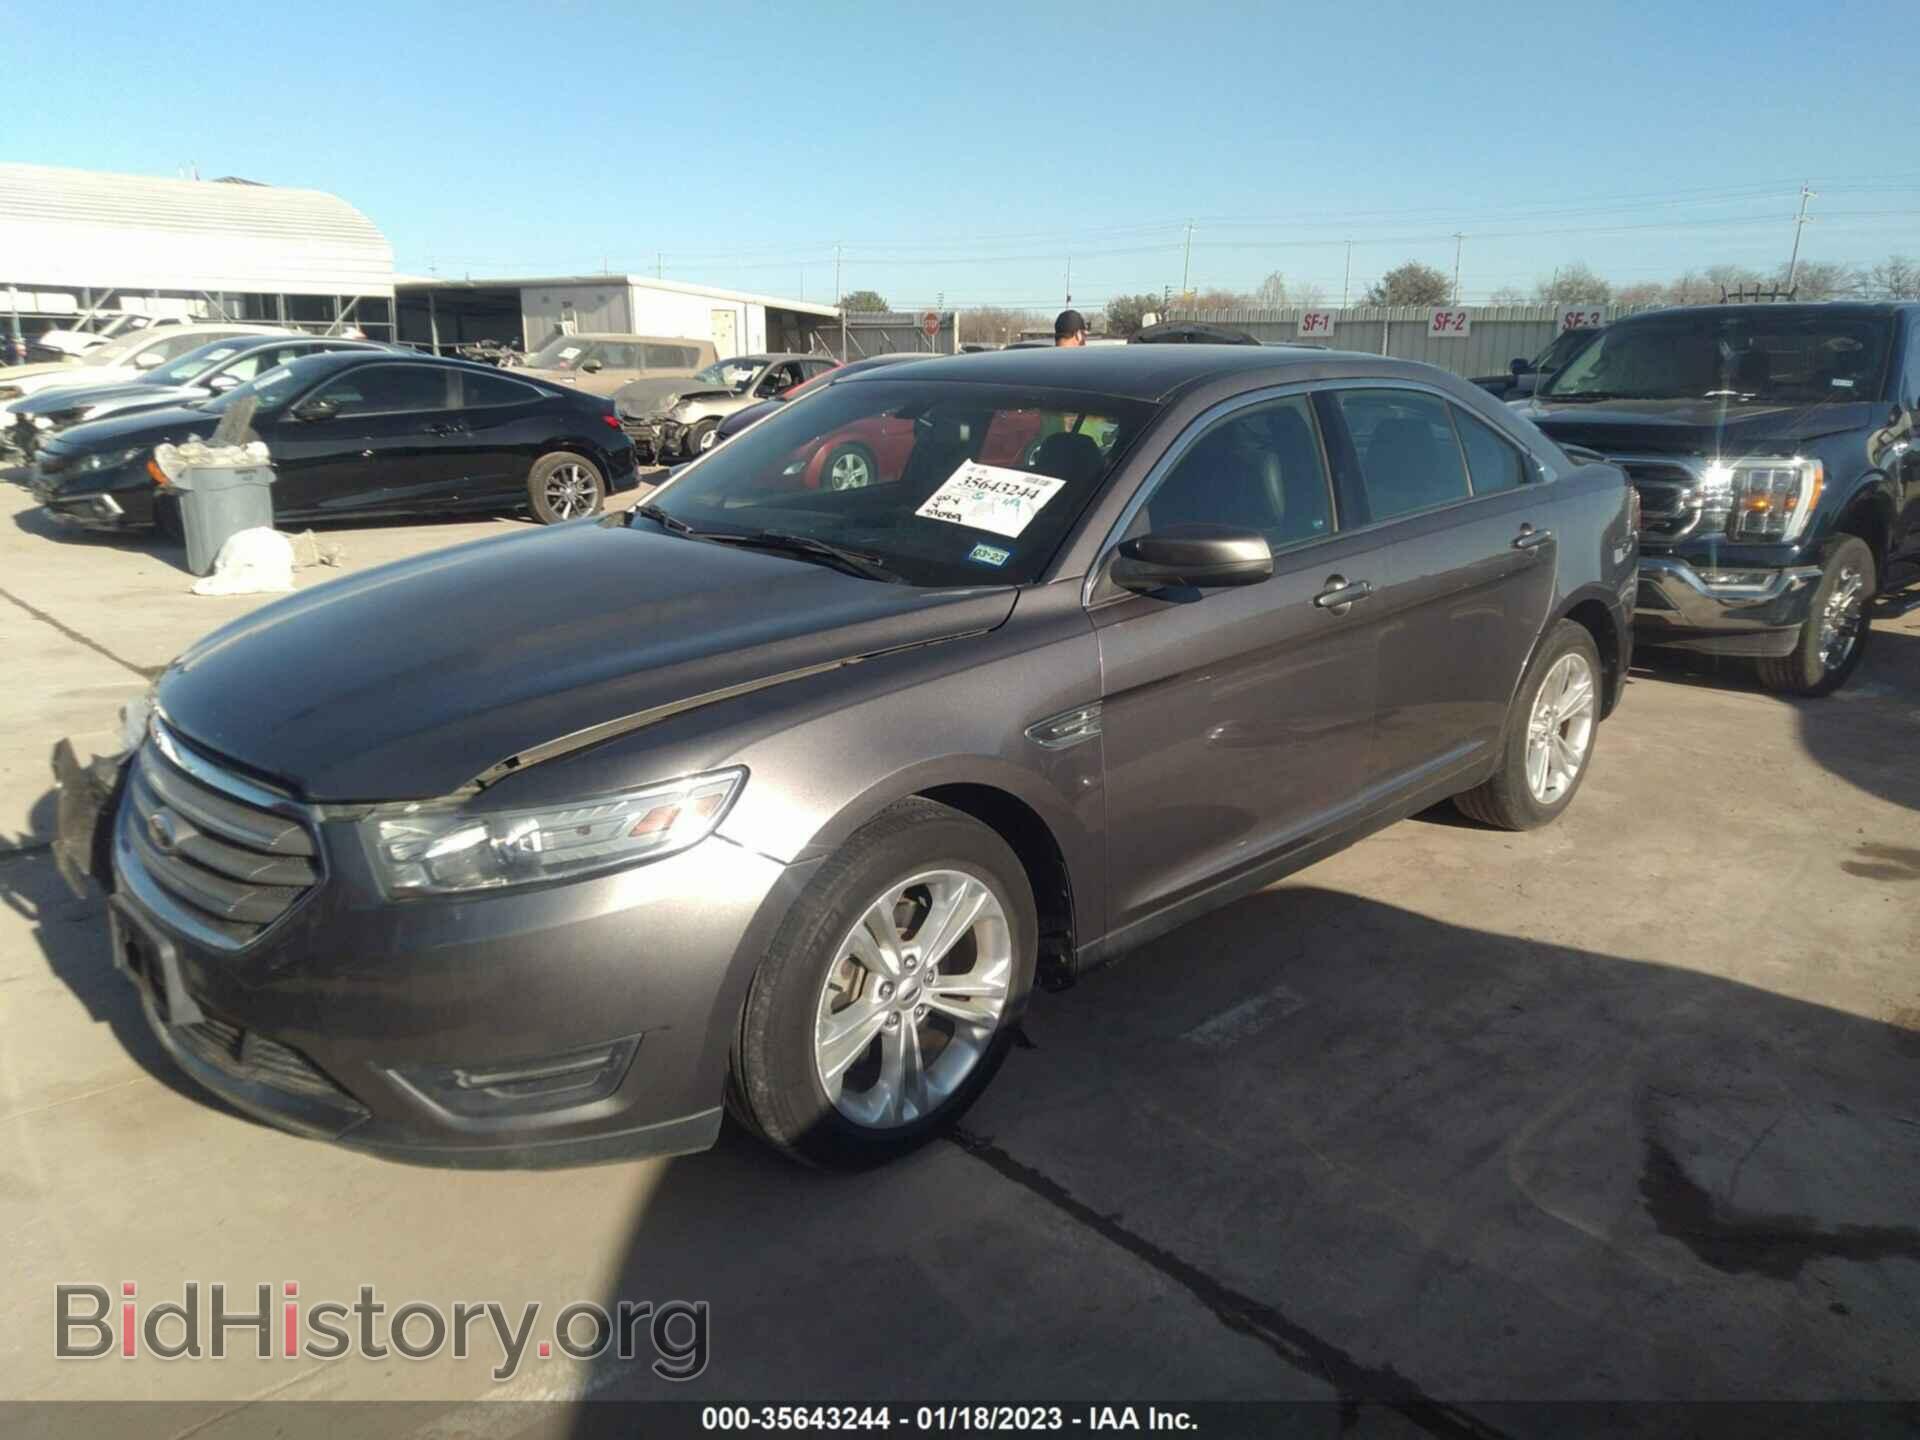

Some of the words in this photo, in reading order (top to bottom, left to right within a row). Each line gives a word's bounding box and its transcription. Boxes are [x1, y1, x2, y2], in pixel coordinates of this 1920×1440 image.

[1303, 314, 1330, 331] SF-1
[1433, 312, 1466, 331] SF-2
[958, 475, 1041, 500] 35643244
